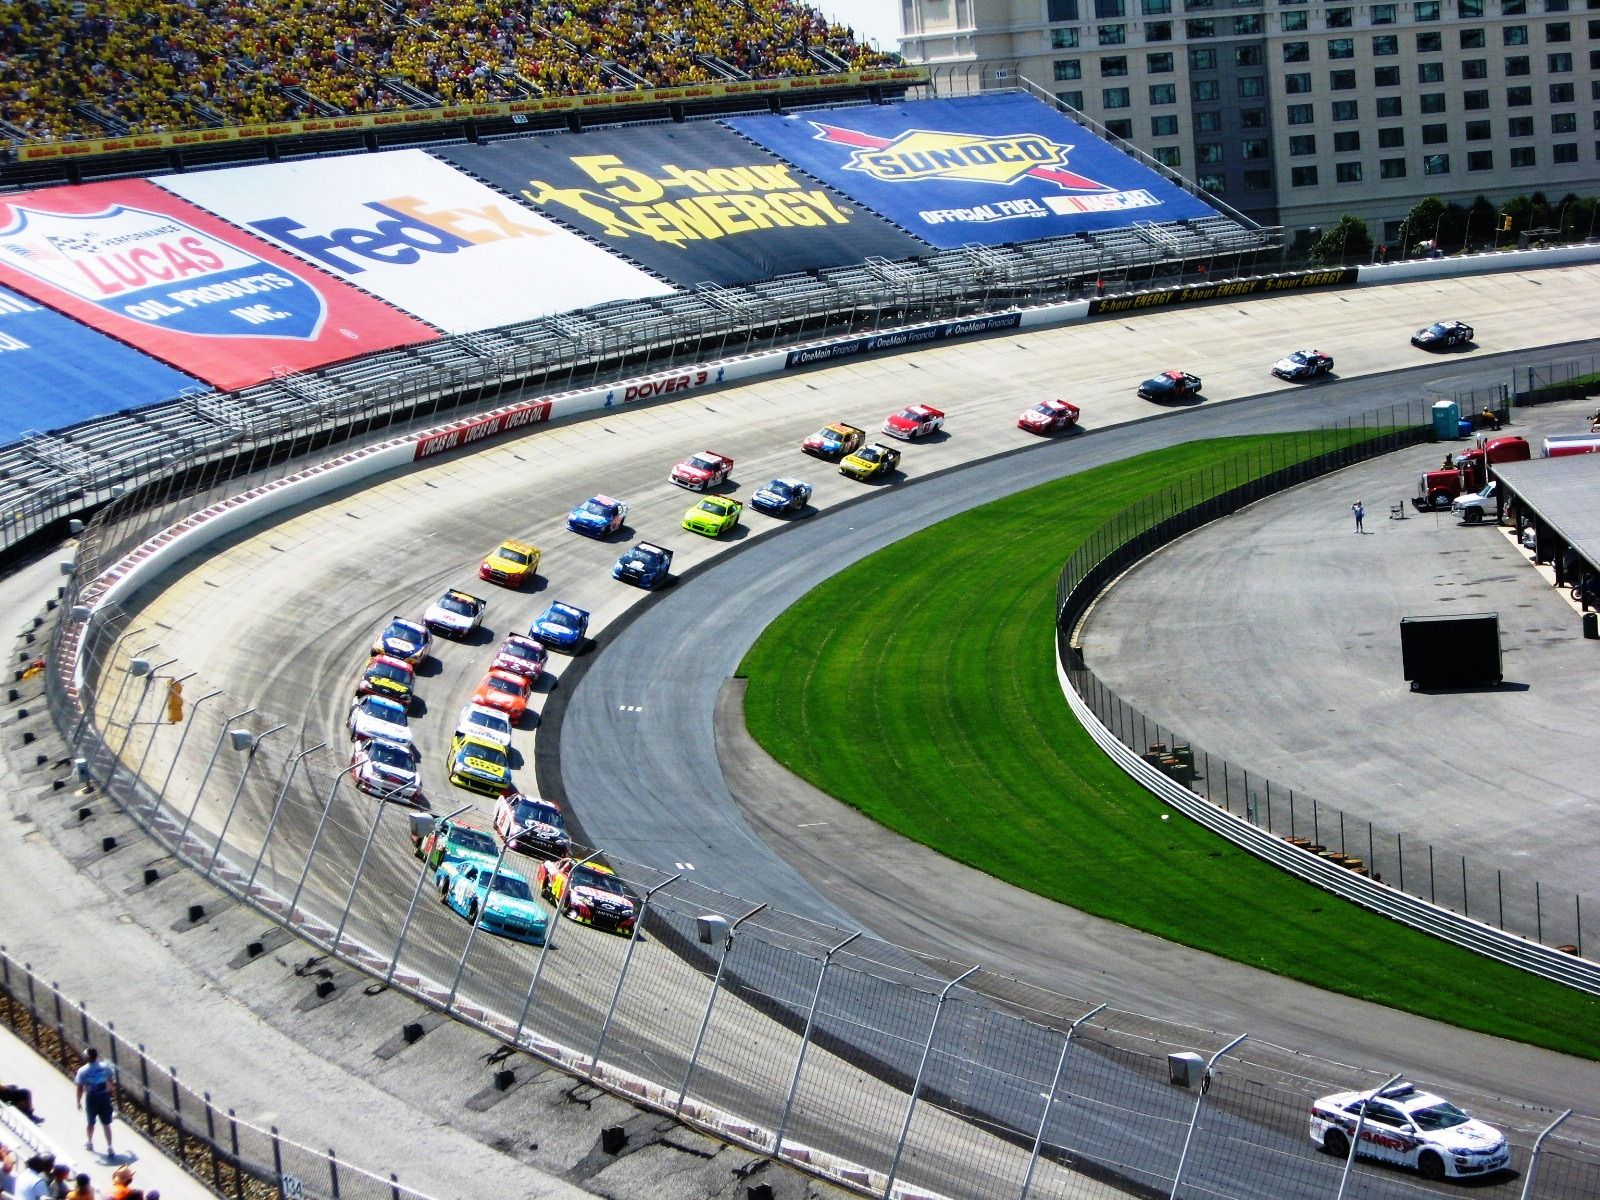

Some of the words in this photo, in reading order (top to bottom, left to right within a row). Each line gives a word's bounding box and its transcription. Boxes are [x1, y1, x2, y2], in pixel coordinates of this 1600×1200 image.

[866, 139, 1052, 177] SUNOCO
[569, 154, 801, 202] 5-hour
[620, 190, 849, 249] ENERGY
[918, 204, 1003, 224] OFFICIAL
[993, 198, 1046, 215] FUEL
[101, 224, 181, 246] PERFORMANCE
[247, 196, 555, 275] FedEx
[74, 236, 225, 294] LUCAS
[1180, 288, 1215, 301] 5-hour
[1216, 281, 1256, 298] ENERGY
[1265, 277, 1300, 291] 5-hour
[1301, 271, 1343, 287] ENERGY
[124, 299, 184, 321] OIL
[166, 272, 294, 307] PRODUCTS
[1099, 299, 1132, 313] 5-hour
[1134, 291, 1174, 308] ENERGY
[954, 322, 986, 336] OneMain
[987, 315, 1016, 330] Financial
[876, 334, 907, 349] OneMain
[908, 328, 937, 342] Financial
[801, 348, 831, 363] OneMain
[624, 375, 691, 402] DOVER
[694, 370, 708, 386] 3
[464, 423, 488, 443] LUCAS
[489, 418, 500, 433] OIL
[505, 411, 528, 430] LUCAS
[528, 406, 544, 423] OIL
[421, 437, 445, 456] LUCAS
[445, 431, 459, 448] OIL
[283, 1176, 304, 1197] 134
